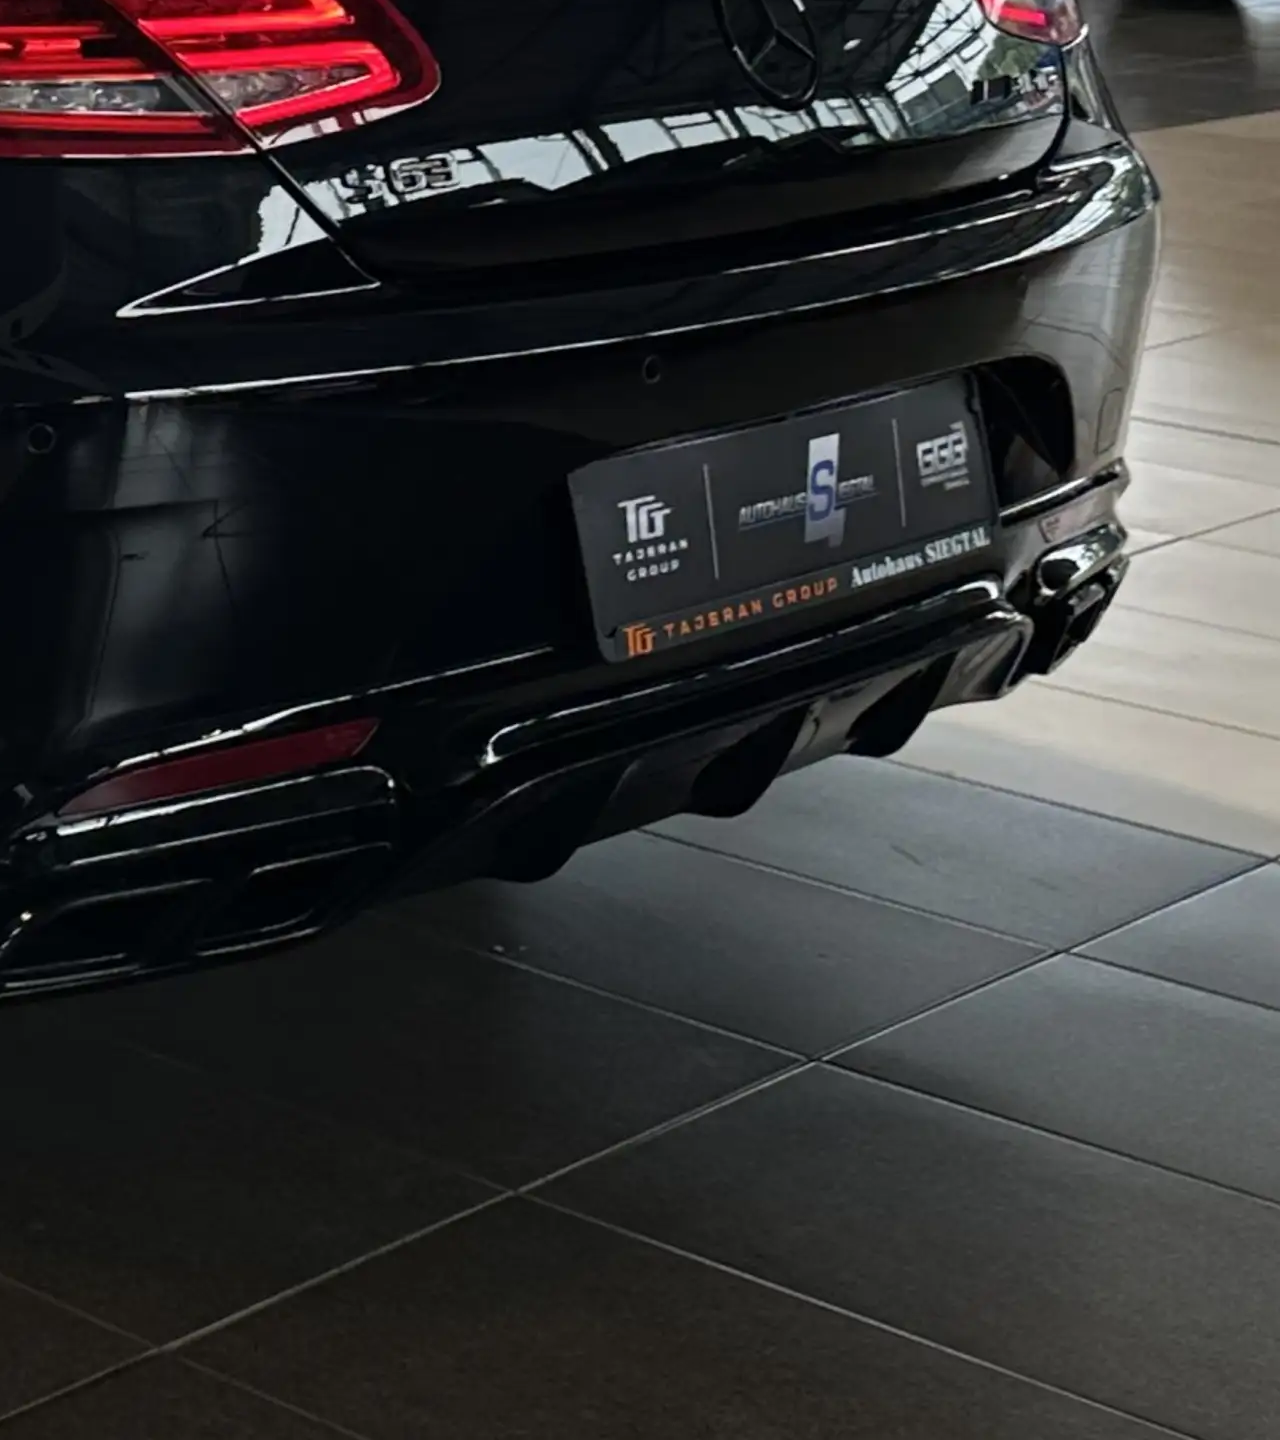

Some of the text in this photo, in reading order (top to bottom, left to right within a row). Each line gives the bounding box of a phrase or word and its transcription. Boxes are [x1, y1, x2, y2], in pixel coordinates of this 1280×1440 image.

[612, 539, 688, 565] TAJERAN
[626, 558, 680, 581] GROUP
[663, 599, 763, 640] TAJERAN
[772, 577, 838, 608] GROUP
[850, 555, 925, 588] Autohaus
[924, 526, 991, 564] SIEGTAL
